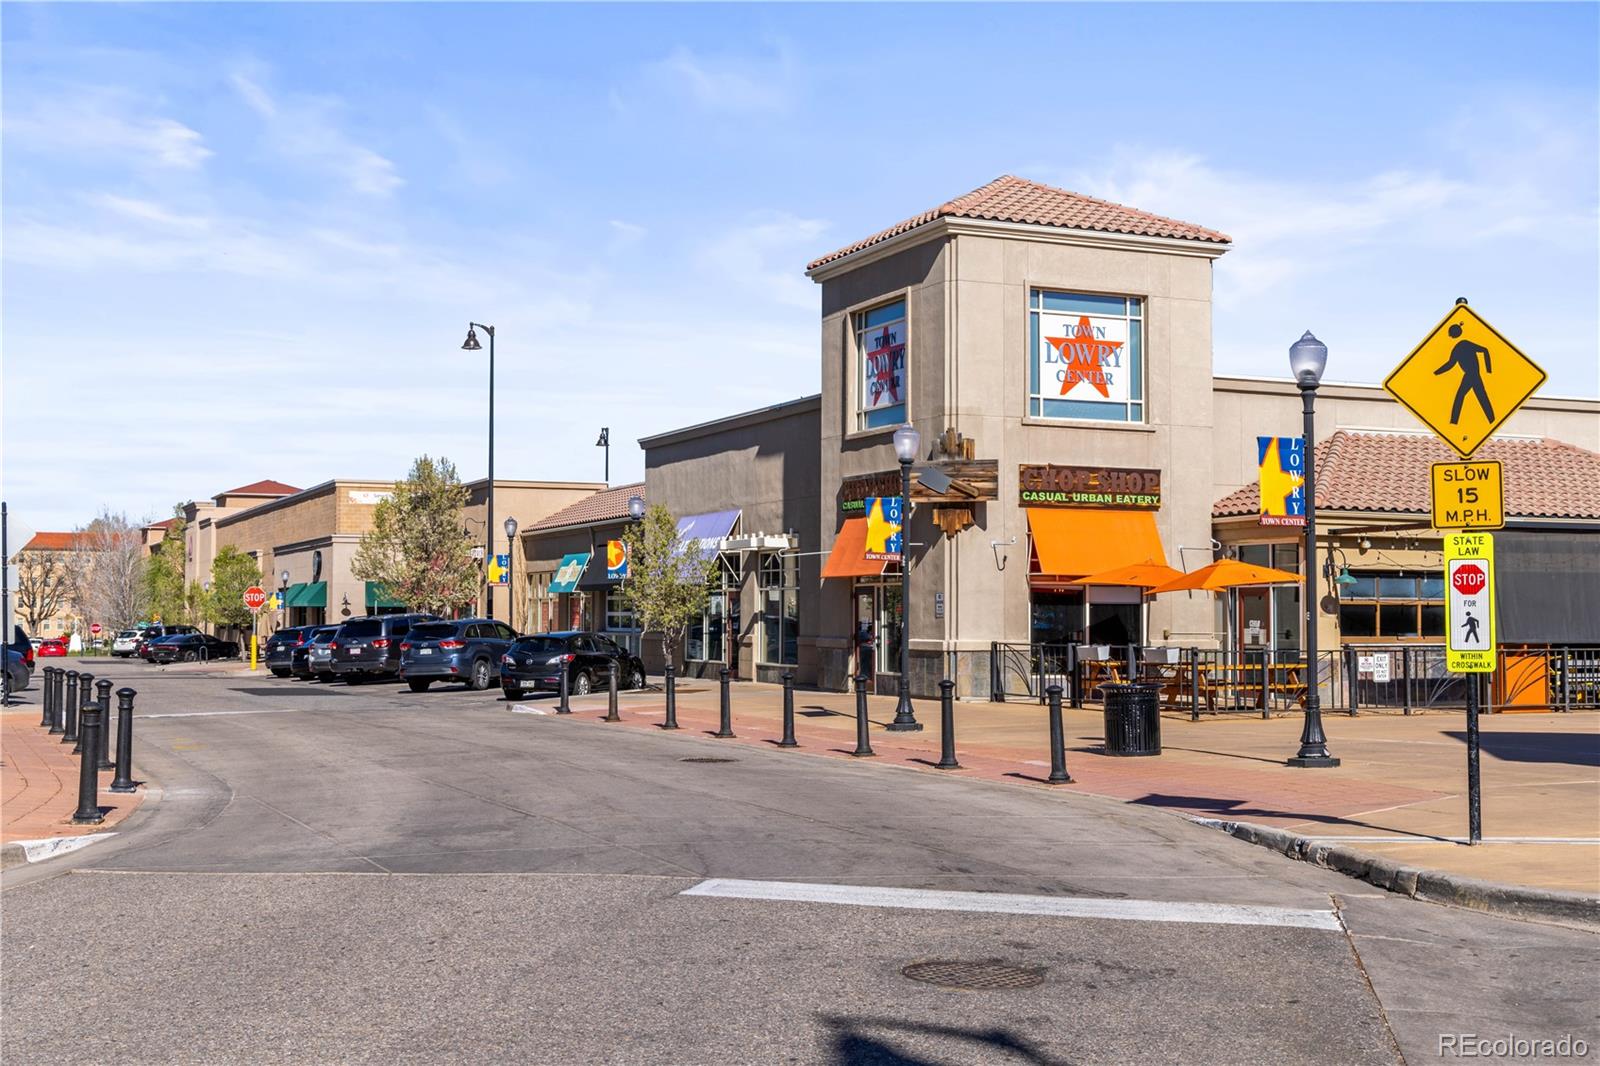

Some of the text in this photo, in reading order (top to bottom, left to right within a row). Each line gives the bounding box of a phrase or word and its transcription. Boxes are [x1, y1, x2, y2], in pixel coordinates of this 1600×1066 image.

[1062, 324, 1106, 339] TOWN
[1044, 341, 1123, 367] LOWRY
[867, 347, 905, 379] LOWRY
[1056, 369, 1114, 386] CENTER
[1023, 467, 1159, 493] CHOP SHOP
[1290, 438, 1301, 515] LOWRY
[1444, 468, 1490, 482] SLOW
[1022, 491, 1159, 504] CASUAL URBAN EATERY
[1457, 487, 1479, 504] 15
[1261, 517, 1305, 526] TOWN CENTER
[1446, 509, 1491, 522] M.P.H.
[890, 498, 899, 553] LOWRY
[1453, 536, 1485, 546] STATE
[1458, 547, 1480, 556] LAW
[1454, 573, 1485, 586] STOP
[245, 593, 265, 602] STOP
[1463, 600, 1477, 608] FOR
[1451, 660, 1492, 669] CROSSWALK
